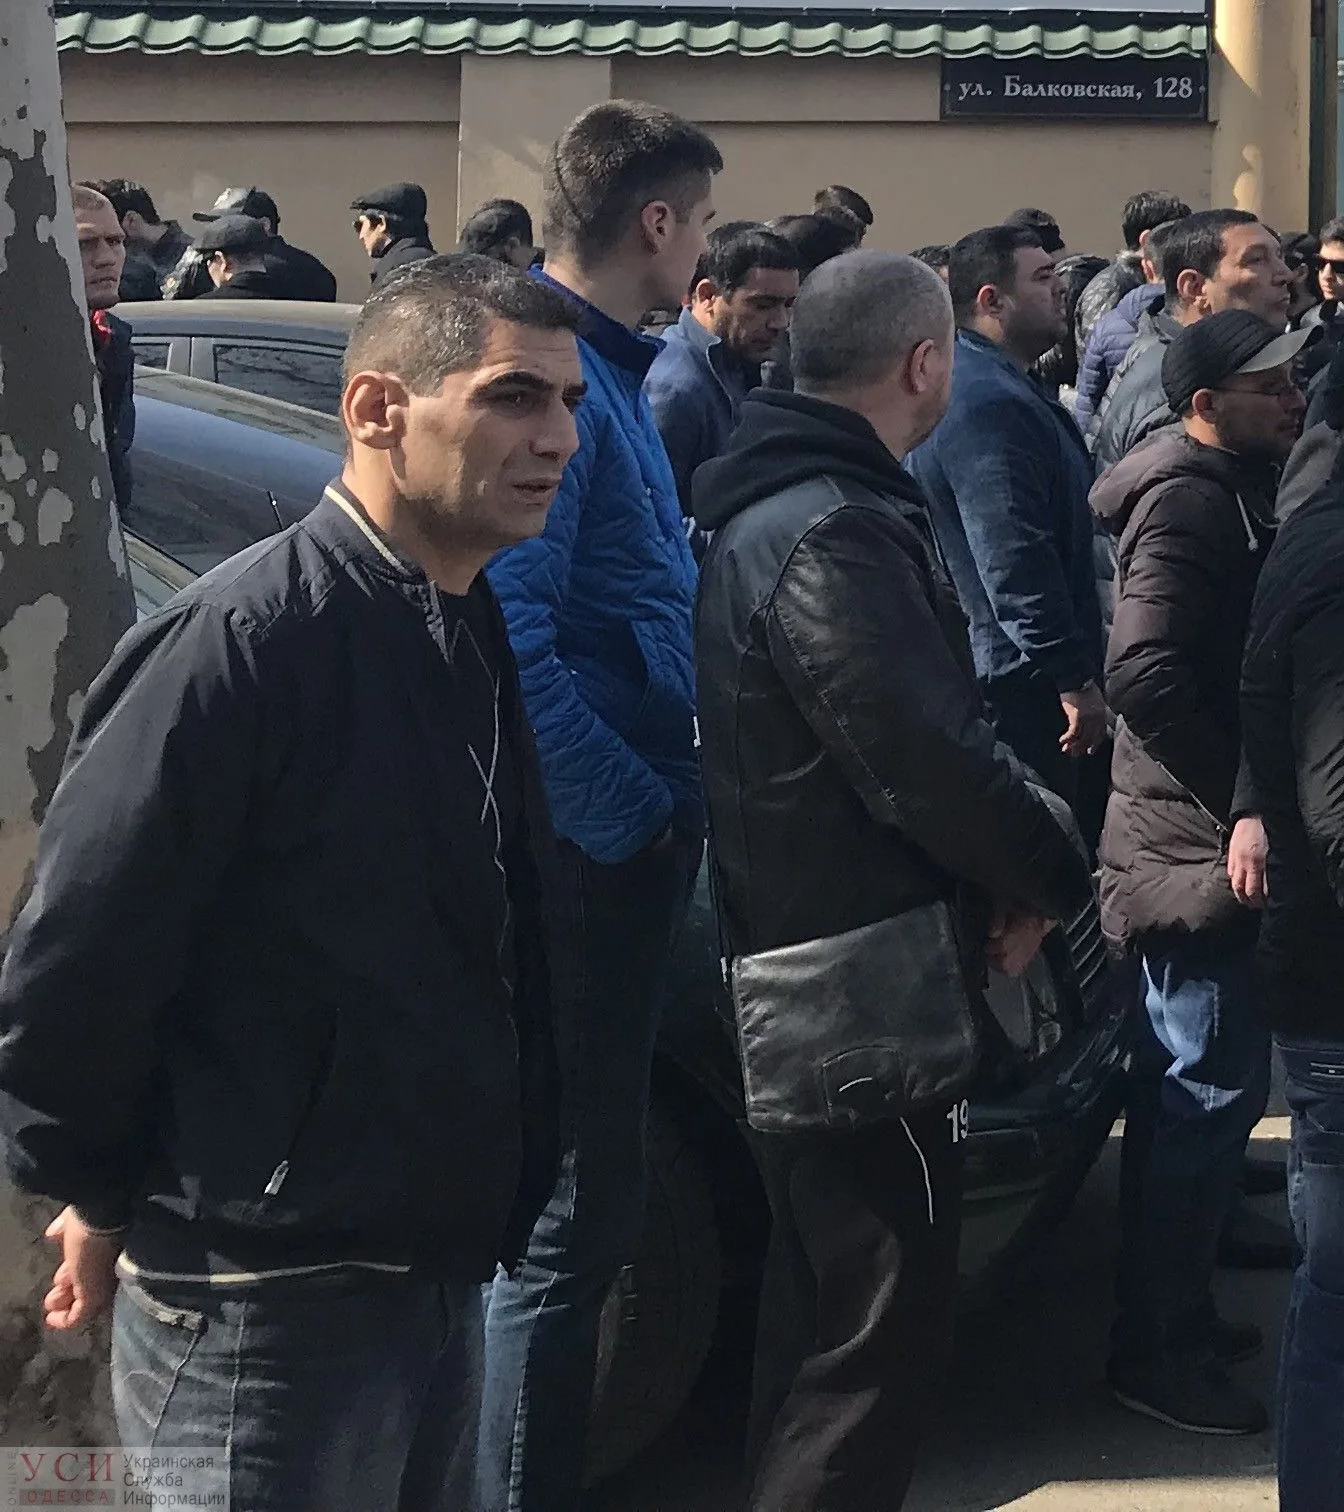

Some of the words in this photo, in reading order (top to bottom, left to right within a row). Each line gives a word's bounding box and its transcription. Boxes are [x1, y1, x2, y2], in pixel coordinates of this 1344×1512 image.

[958, 82, 993, 100] ул.
[1003, 75, 1143, 100] Балковская,
[1153, 76, 1194, 99] 128
